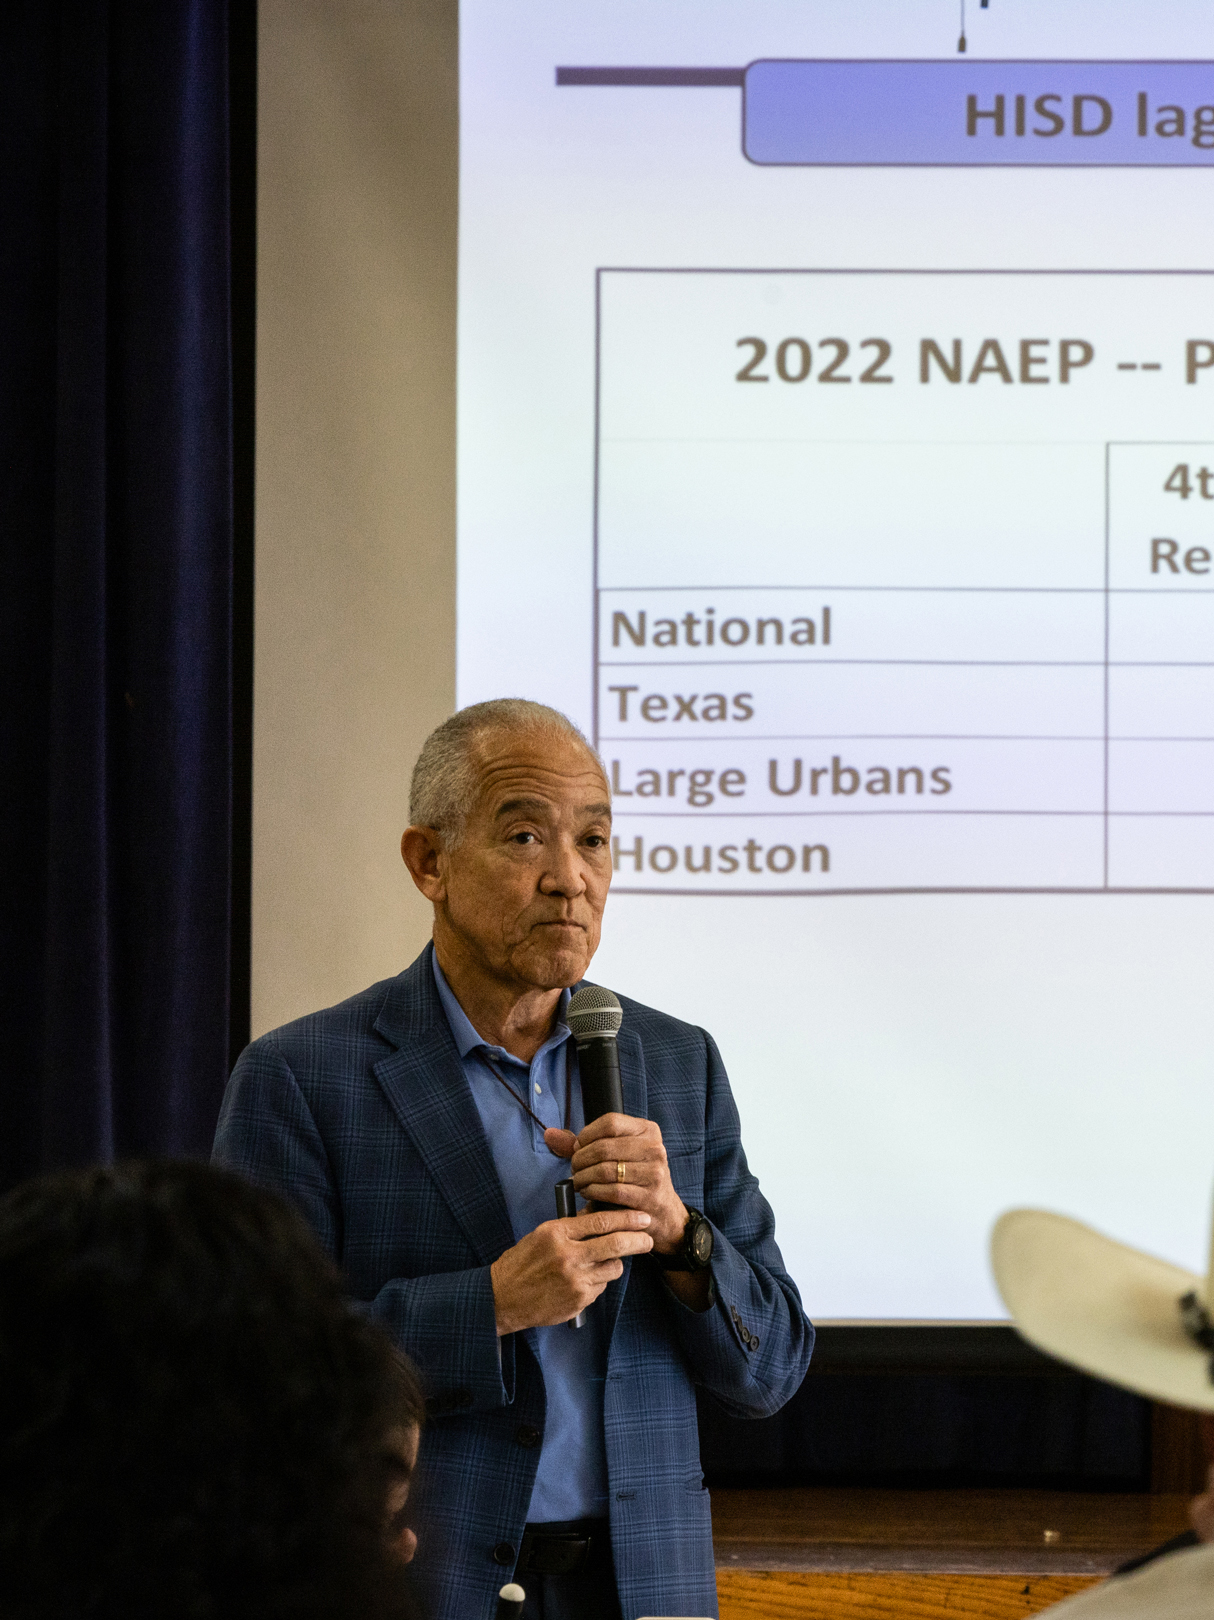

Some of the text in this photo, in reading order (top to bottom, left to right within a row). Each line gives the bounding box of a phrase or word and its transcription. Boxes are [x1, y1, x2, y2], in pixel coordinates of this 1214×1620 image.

[966, 93, 1114, 138] HISD
[735, 336, 894, 385] 2022
[919, 337, 1095, 385] NAEP
[611, 605, 832, 649] National
[608, 684, 755, 724] Texas
[611, 754, 953, 807] Large Urbans
[612, 835, 831, 875] Houston
